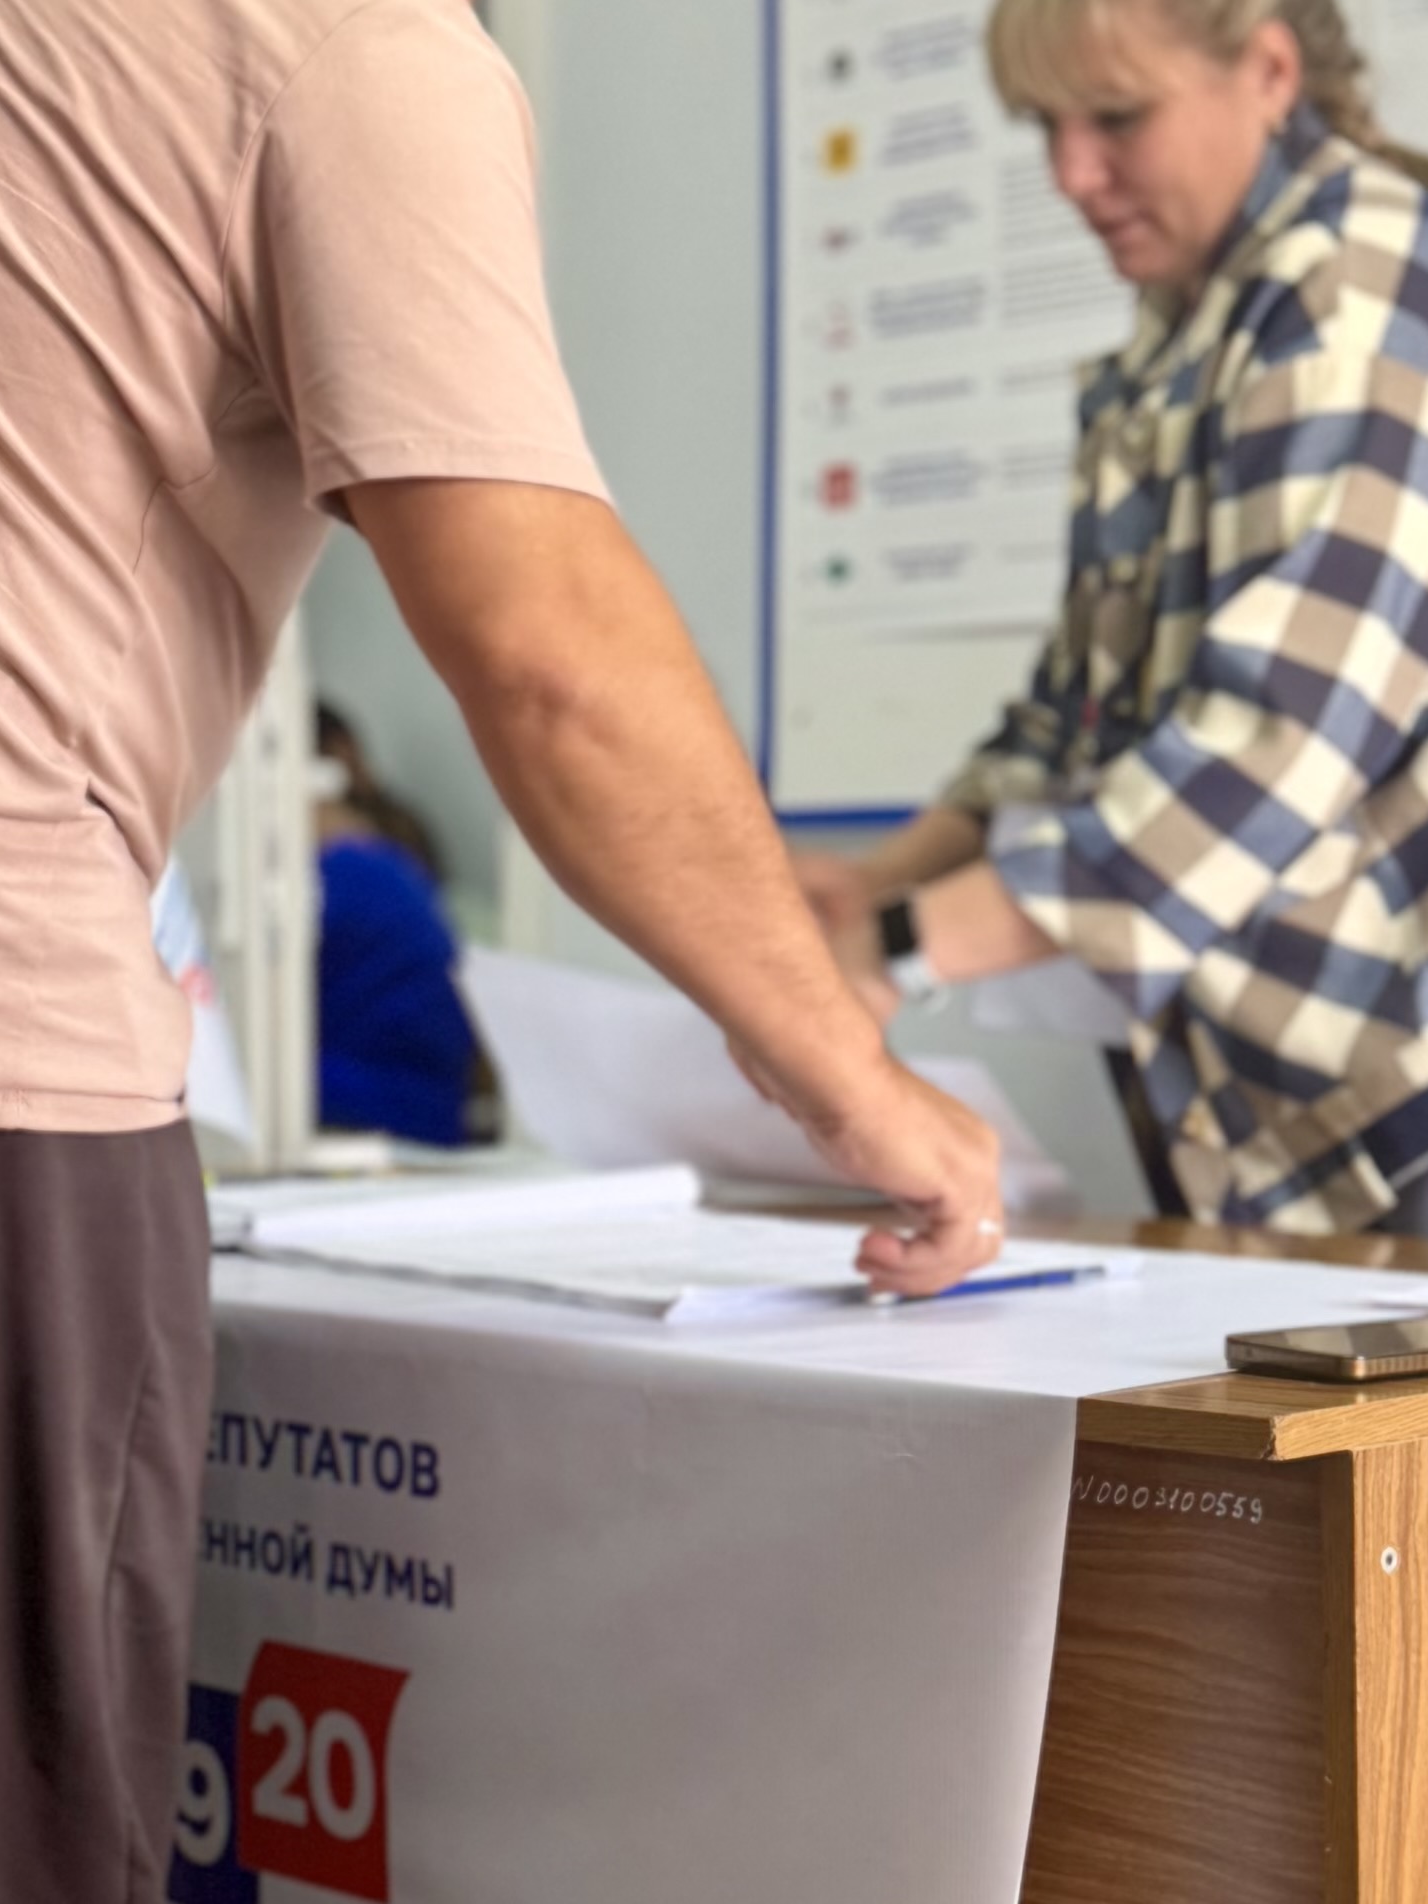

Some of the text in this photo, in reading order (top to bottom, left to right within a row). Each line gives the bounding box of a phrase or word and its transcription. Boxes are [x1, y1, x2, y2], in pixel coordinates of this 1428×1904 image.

[206, 1412, 441, 1498] ПУТАТОВ
[201, 1518, 455, 1610] ННОЙ ДУМЫ
[251, 1695, 377, 1843] 20
